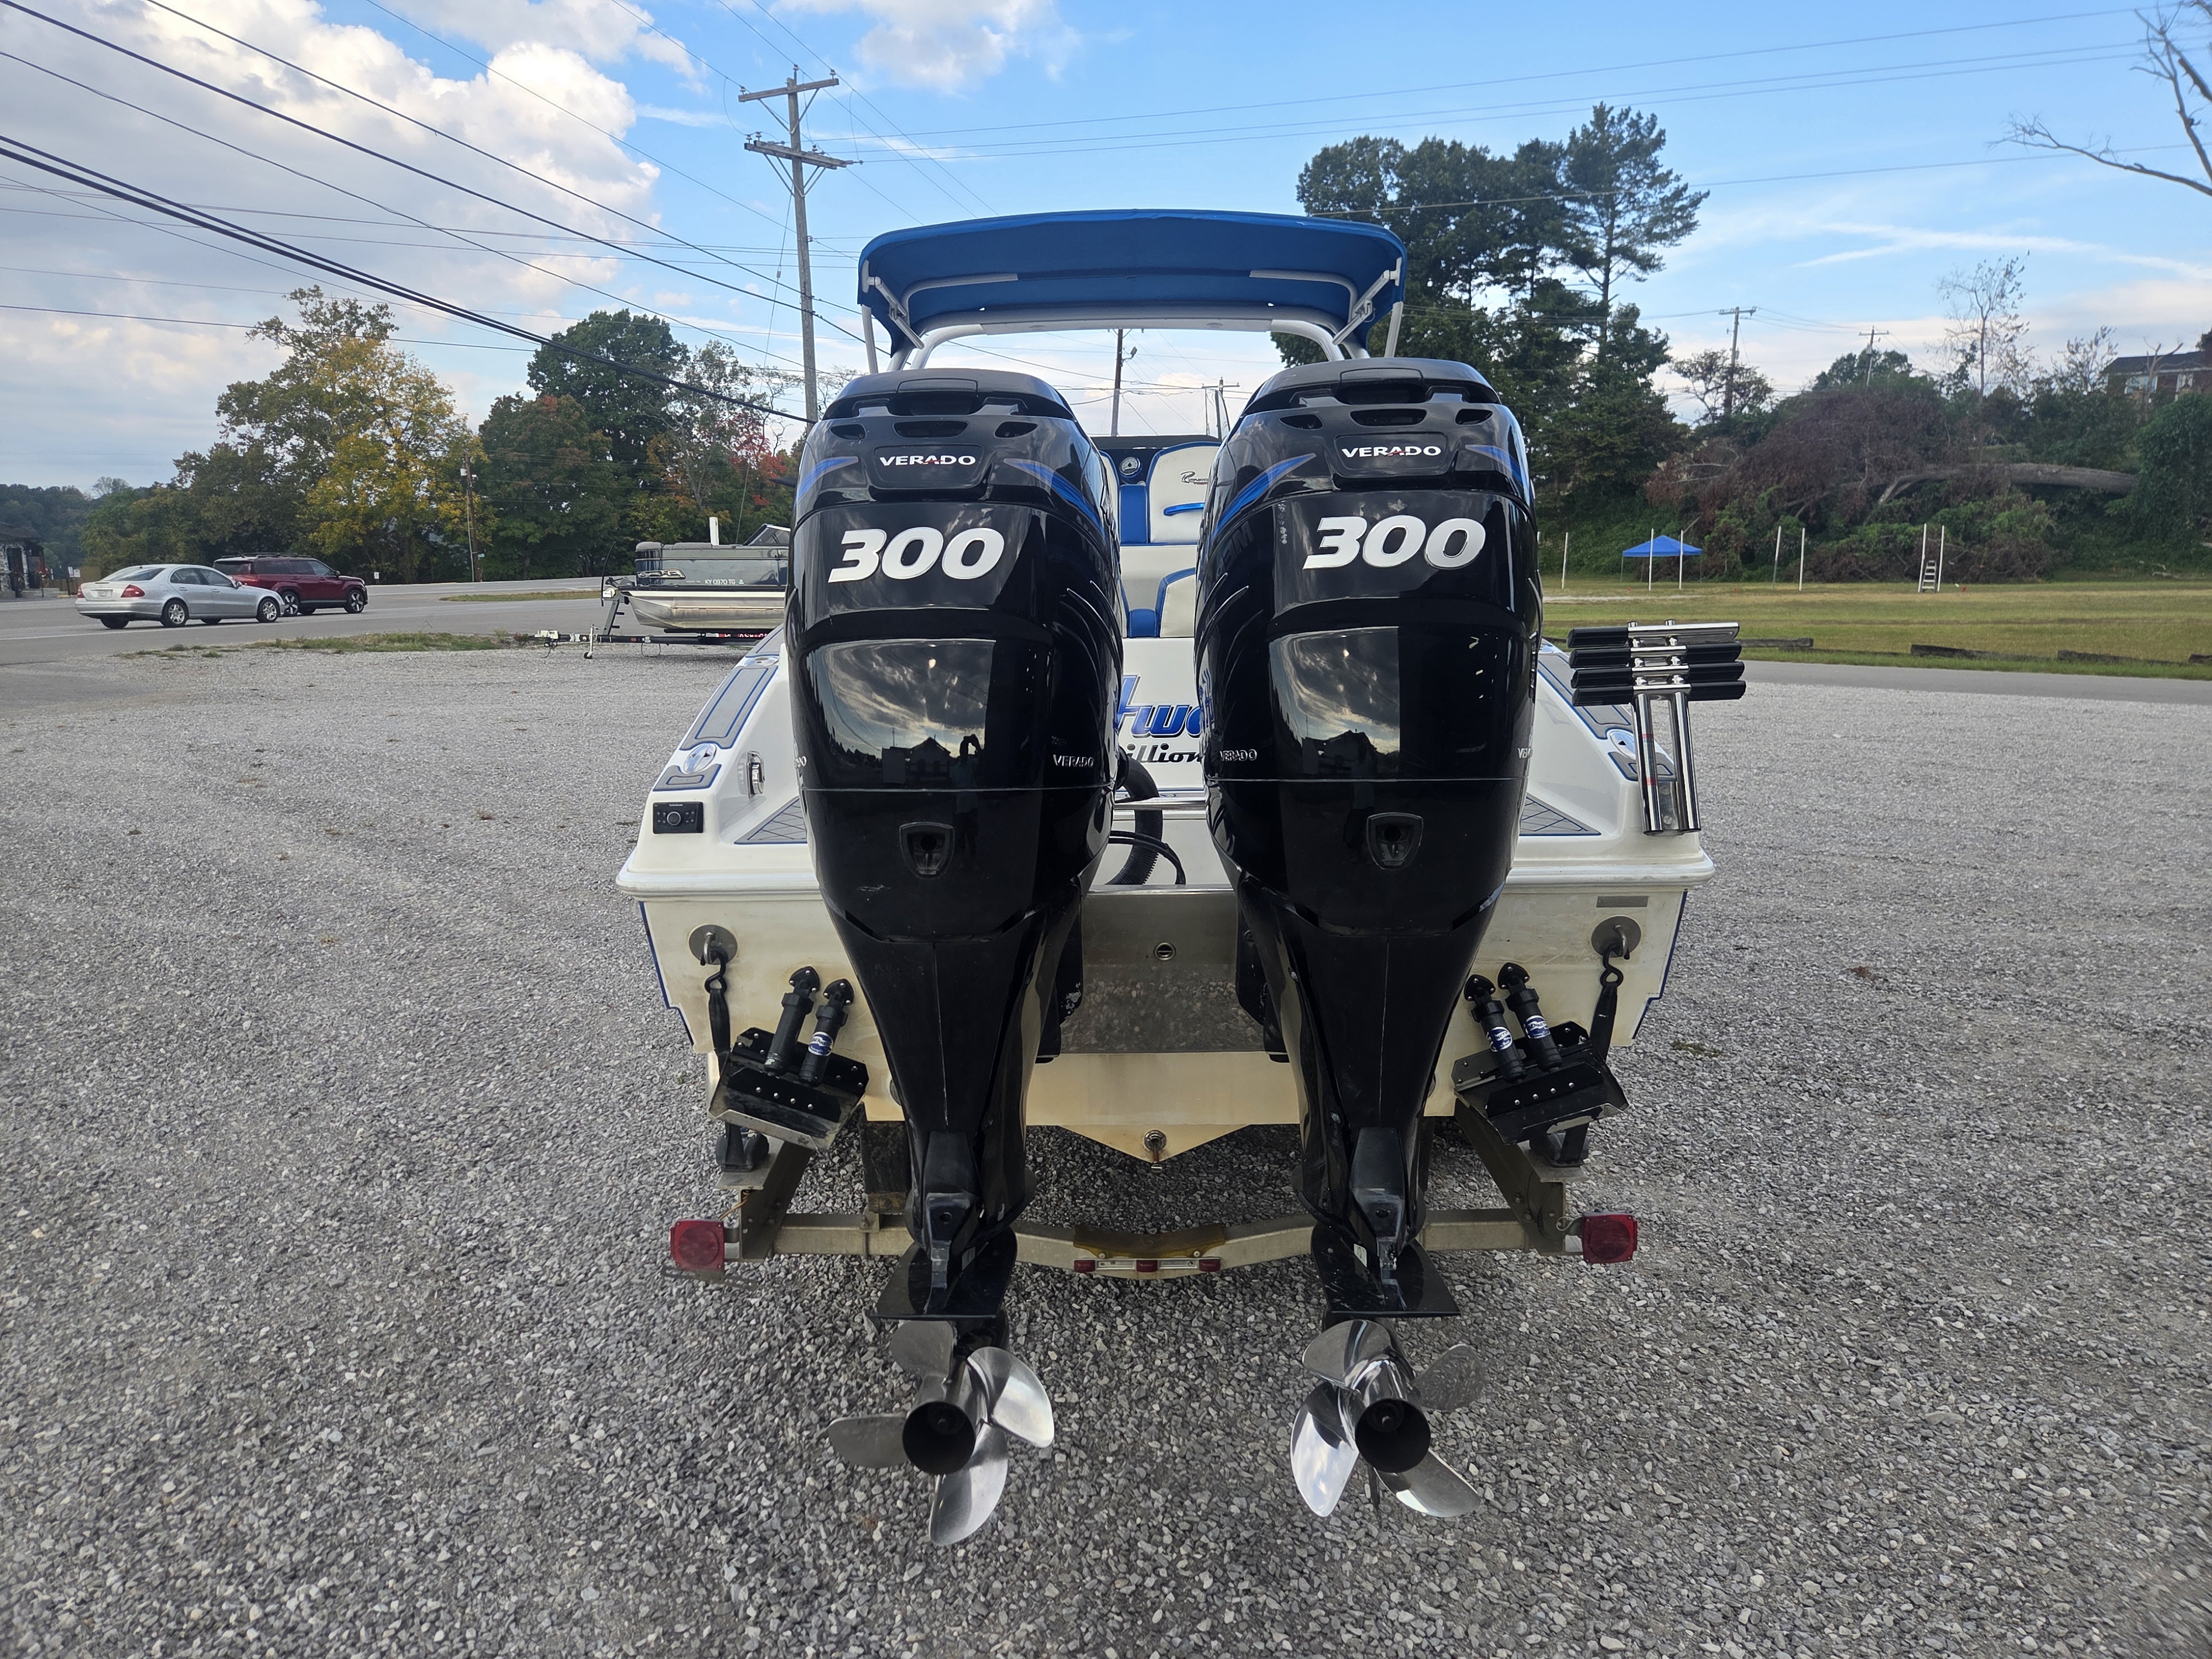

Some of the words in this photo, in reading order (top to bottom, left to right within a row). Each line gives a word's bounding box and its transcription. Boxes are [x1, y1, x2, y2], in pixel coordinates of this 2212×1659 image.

[1342, 446, 1441, 458] VERADO
[879, 455, 976, 466] VERADO
[1303, 515, 1486, 571] 300
[828, 526, 1005, 583] 300
[1053, 754, 1094, 768] VERADO
[1219, 748, 1258, 761] VERADO
